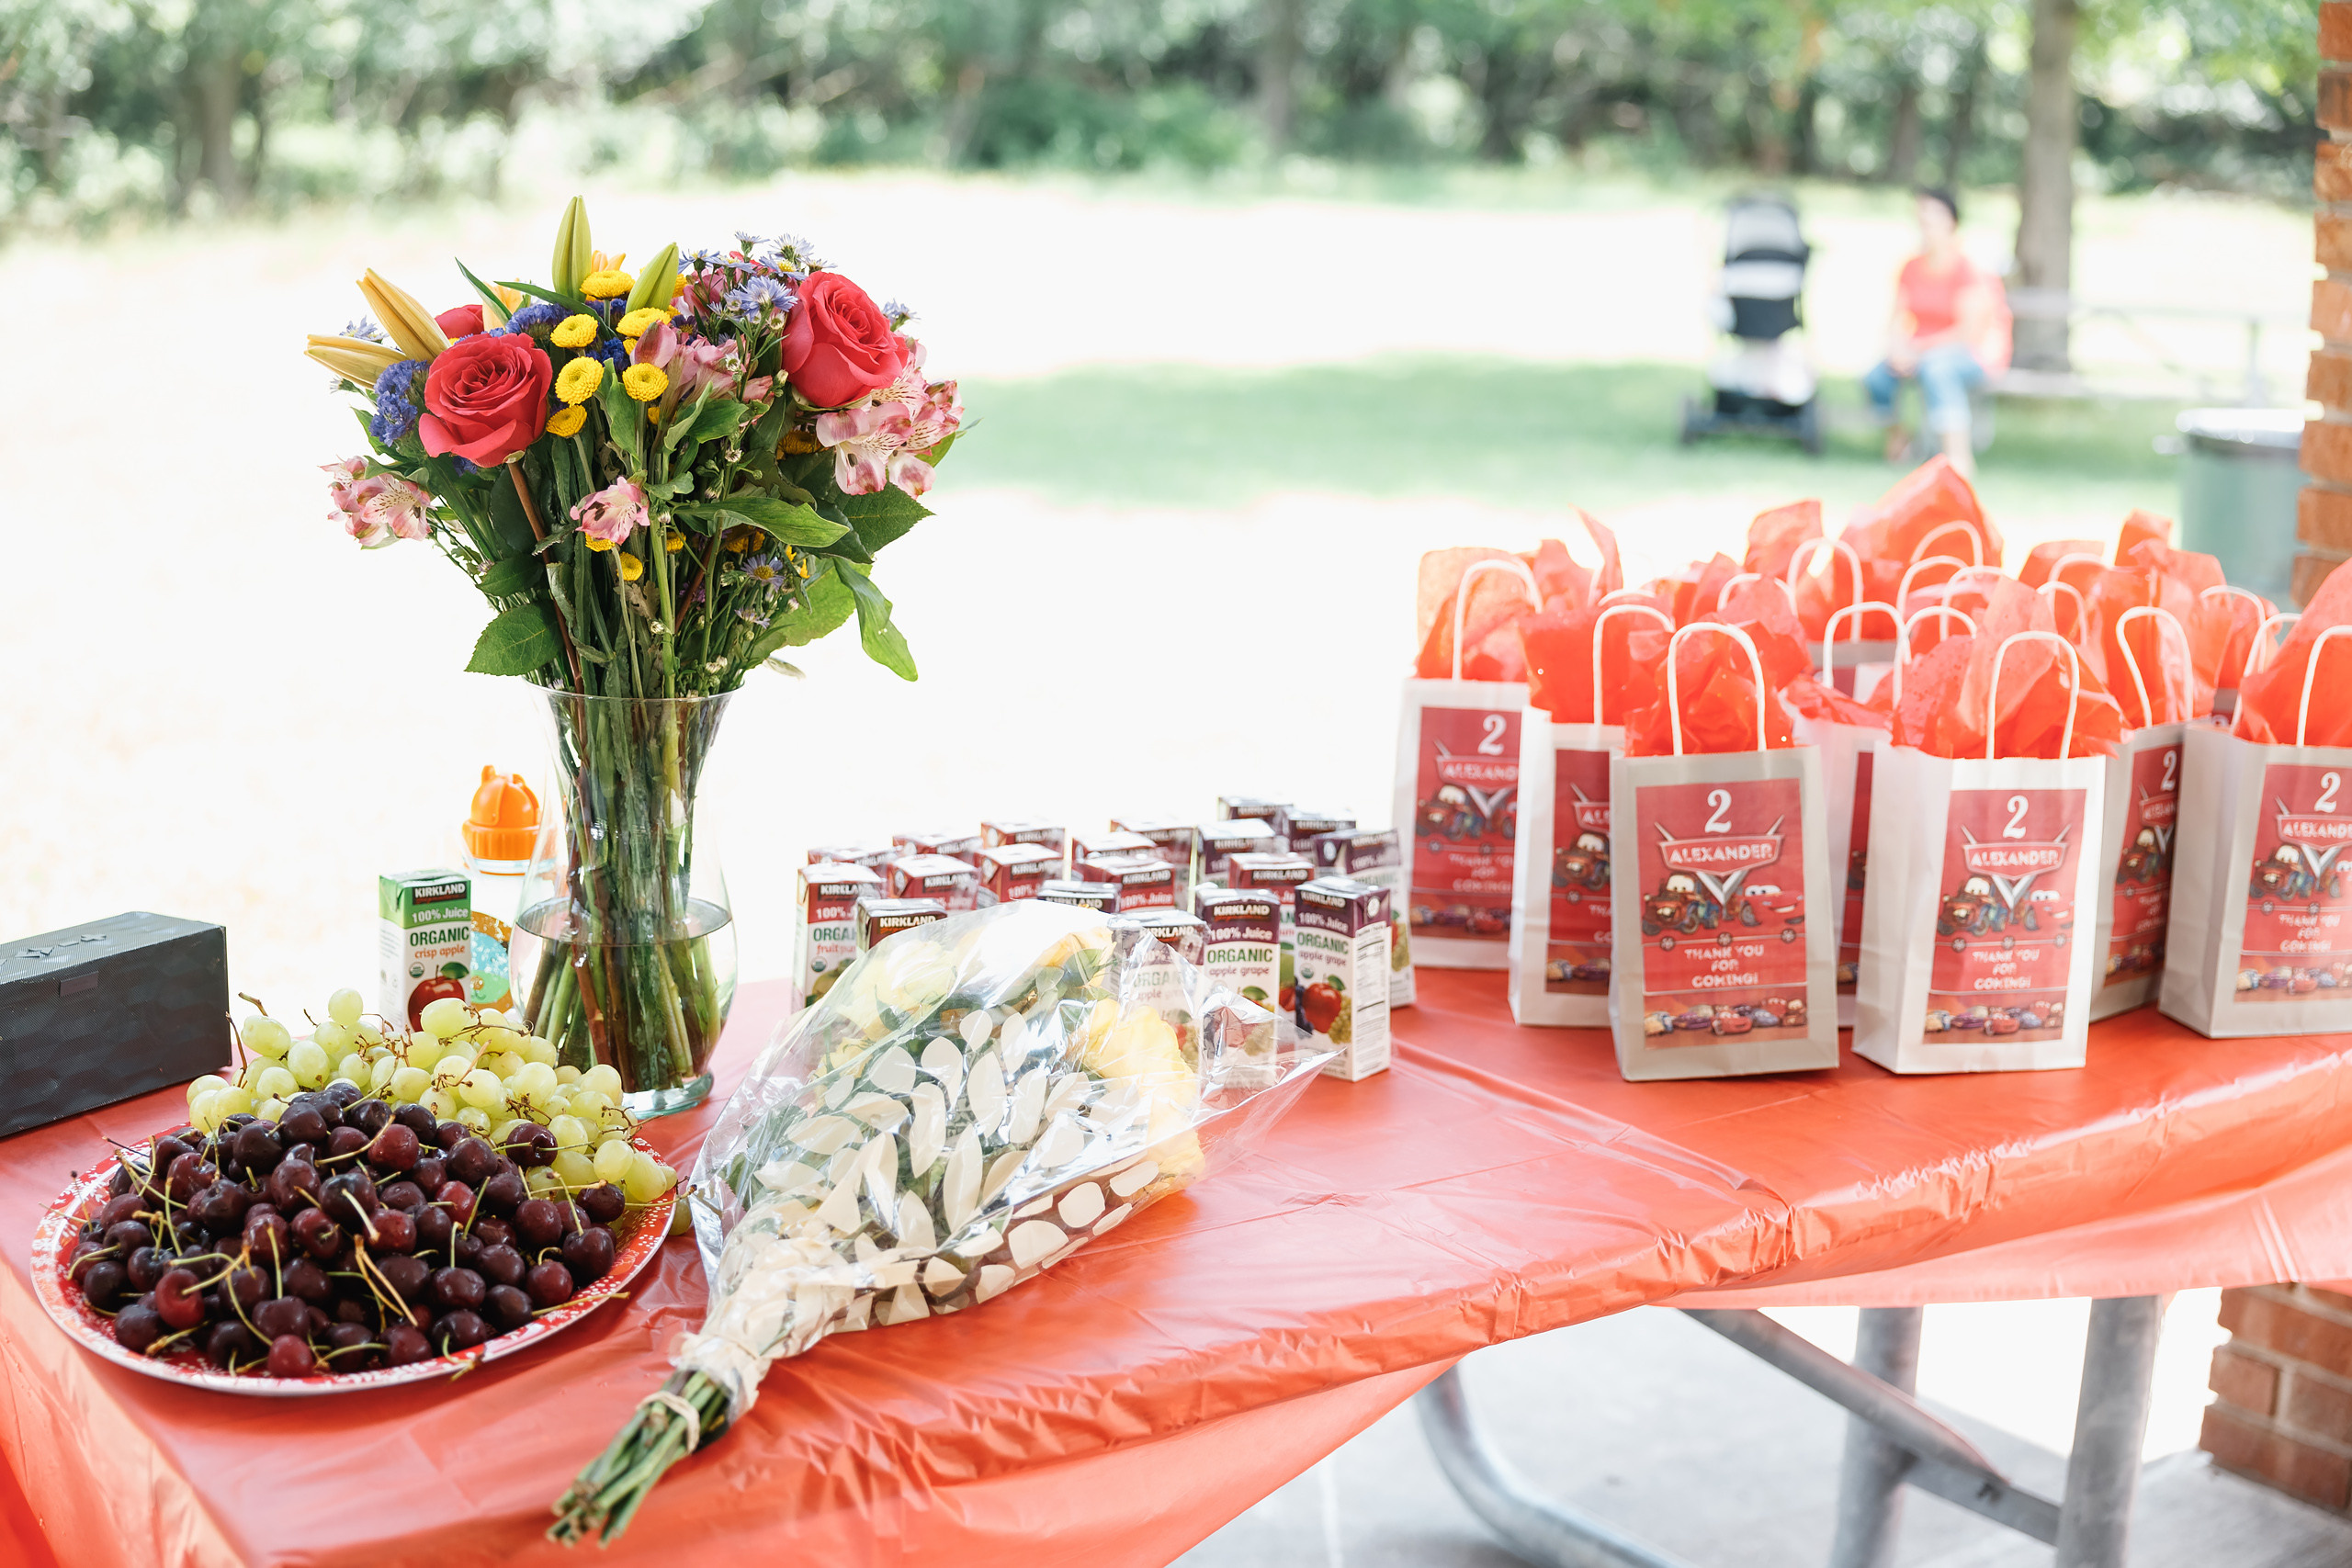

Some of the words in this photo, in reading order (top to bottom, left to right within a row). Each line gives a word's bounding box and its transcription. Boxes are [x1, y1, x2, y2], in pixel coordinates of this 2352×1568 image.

[1477, 714, 1508, 756] 2
[1443, 762, 1519, 781] ALEXAND
[2161, 750, 2177, 792] 2
[2313, 772, 2342, 814] 2
[1704, 789, 1732, 833] 2
[2003, 795, 2029, 839] 2
[2282, 822, 2352, 840] ALEXANDE
[1669, 842, 1773, 863] ALEXANDER
[1970, 849, 2060, 867] ALEXANDER
[414, 883, 466, 898] KIRKLAND
[820, 884, 862, 896] KIRKLA
[1046, 897, 1102, 909] KLAND
[1300, 890, 1347, 908] KIRKLAND
[412, 908, 442, 923] 100%
[443, 907, 469, 919] Juice
[816, 906, 845, 919] 100%
[1213, 904, 1271, 917] KIRKLAND
[879, 915, 936, 928] KIRKLAND
[1298, 911, 1325, 926] 100%
[1325, 916, 1349, 933] Juice
[410, 926, 469, 947] ORGANIC
[813, 927, 856, 942] ORGA
[1140, 926, 1194, 938] RKLAND
[1211, 926, 1241, 941] 100%
[1242, 926, 1273, 941] Juice
[816, 943, 838, 954] fruit
[1297, 931, 1349, 954] ORGANIC
[414, 947, 438, 960] crisp
[439, 943, 466, 958] apple
[1207, 948, 1273, 964] ORGANIC
[1684, 947, 1733, 960] THANK
[1736, 944, 1764, 958] YOU
[1973, 950, 2013, 964] THANK
[2016, 949, 2040, 962] YOU
[1209, 964, 1237, 976] apple
[1239, 965, 1270, 977] grape
[1711, 959, 1739, 973] FOR
[1992, 963, 2017, 976] FOR
[1691, 974, 1759, 989] COMING!
[1973, 976, 2031, 991] COMING!
